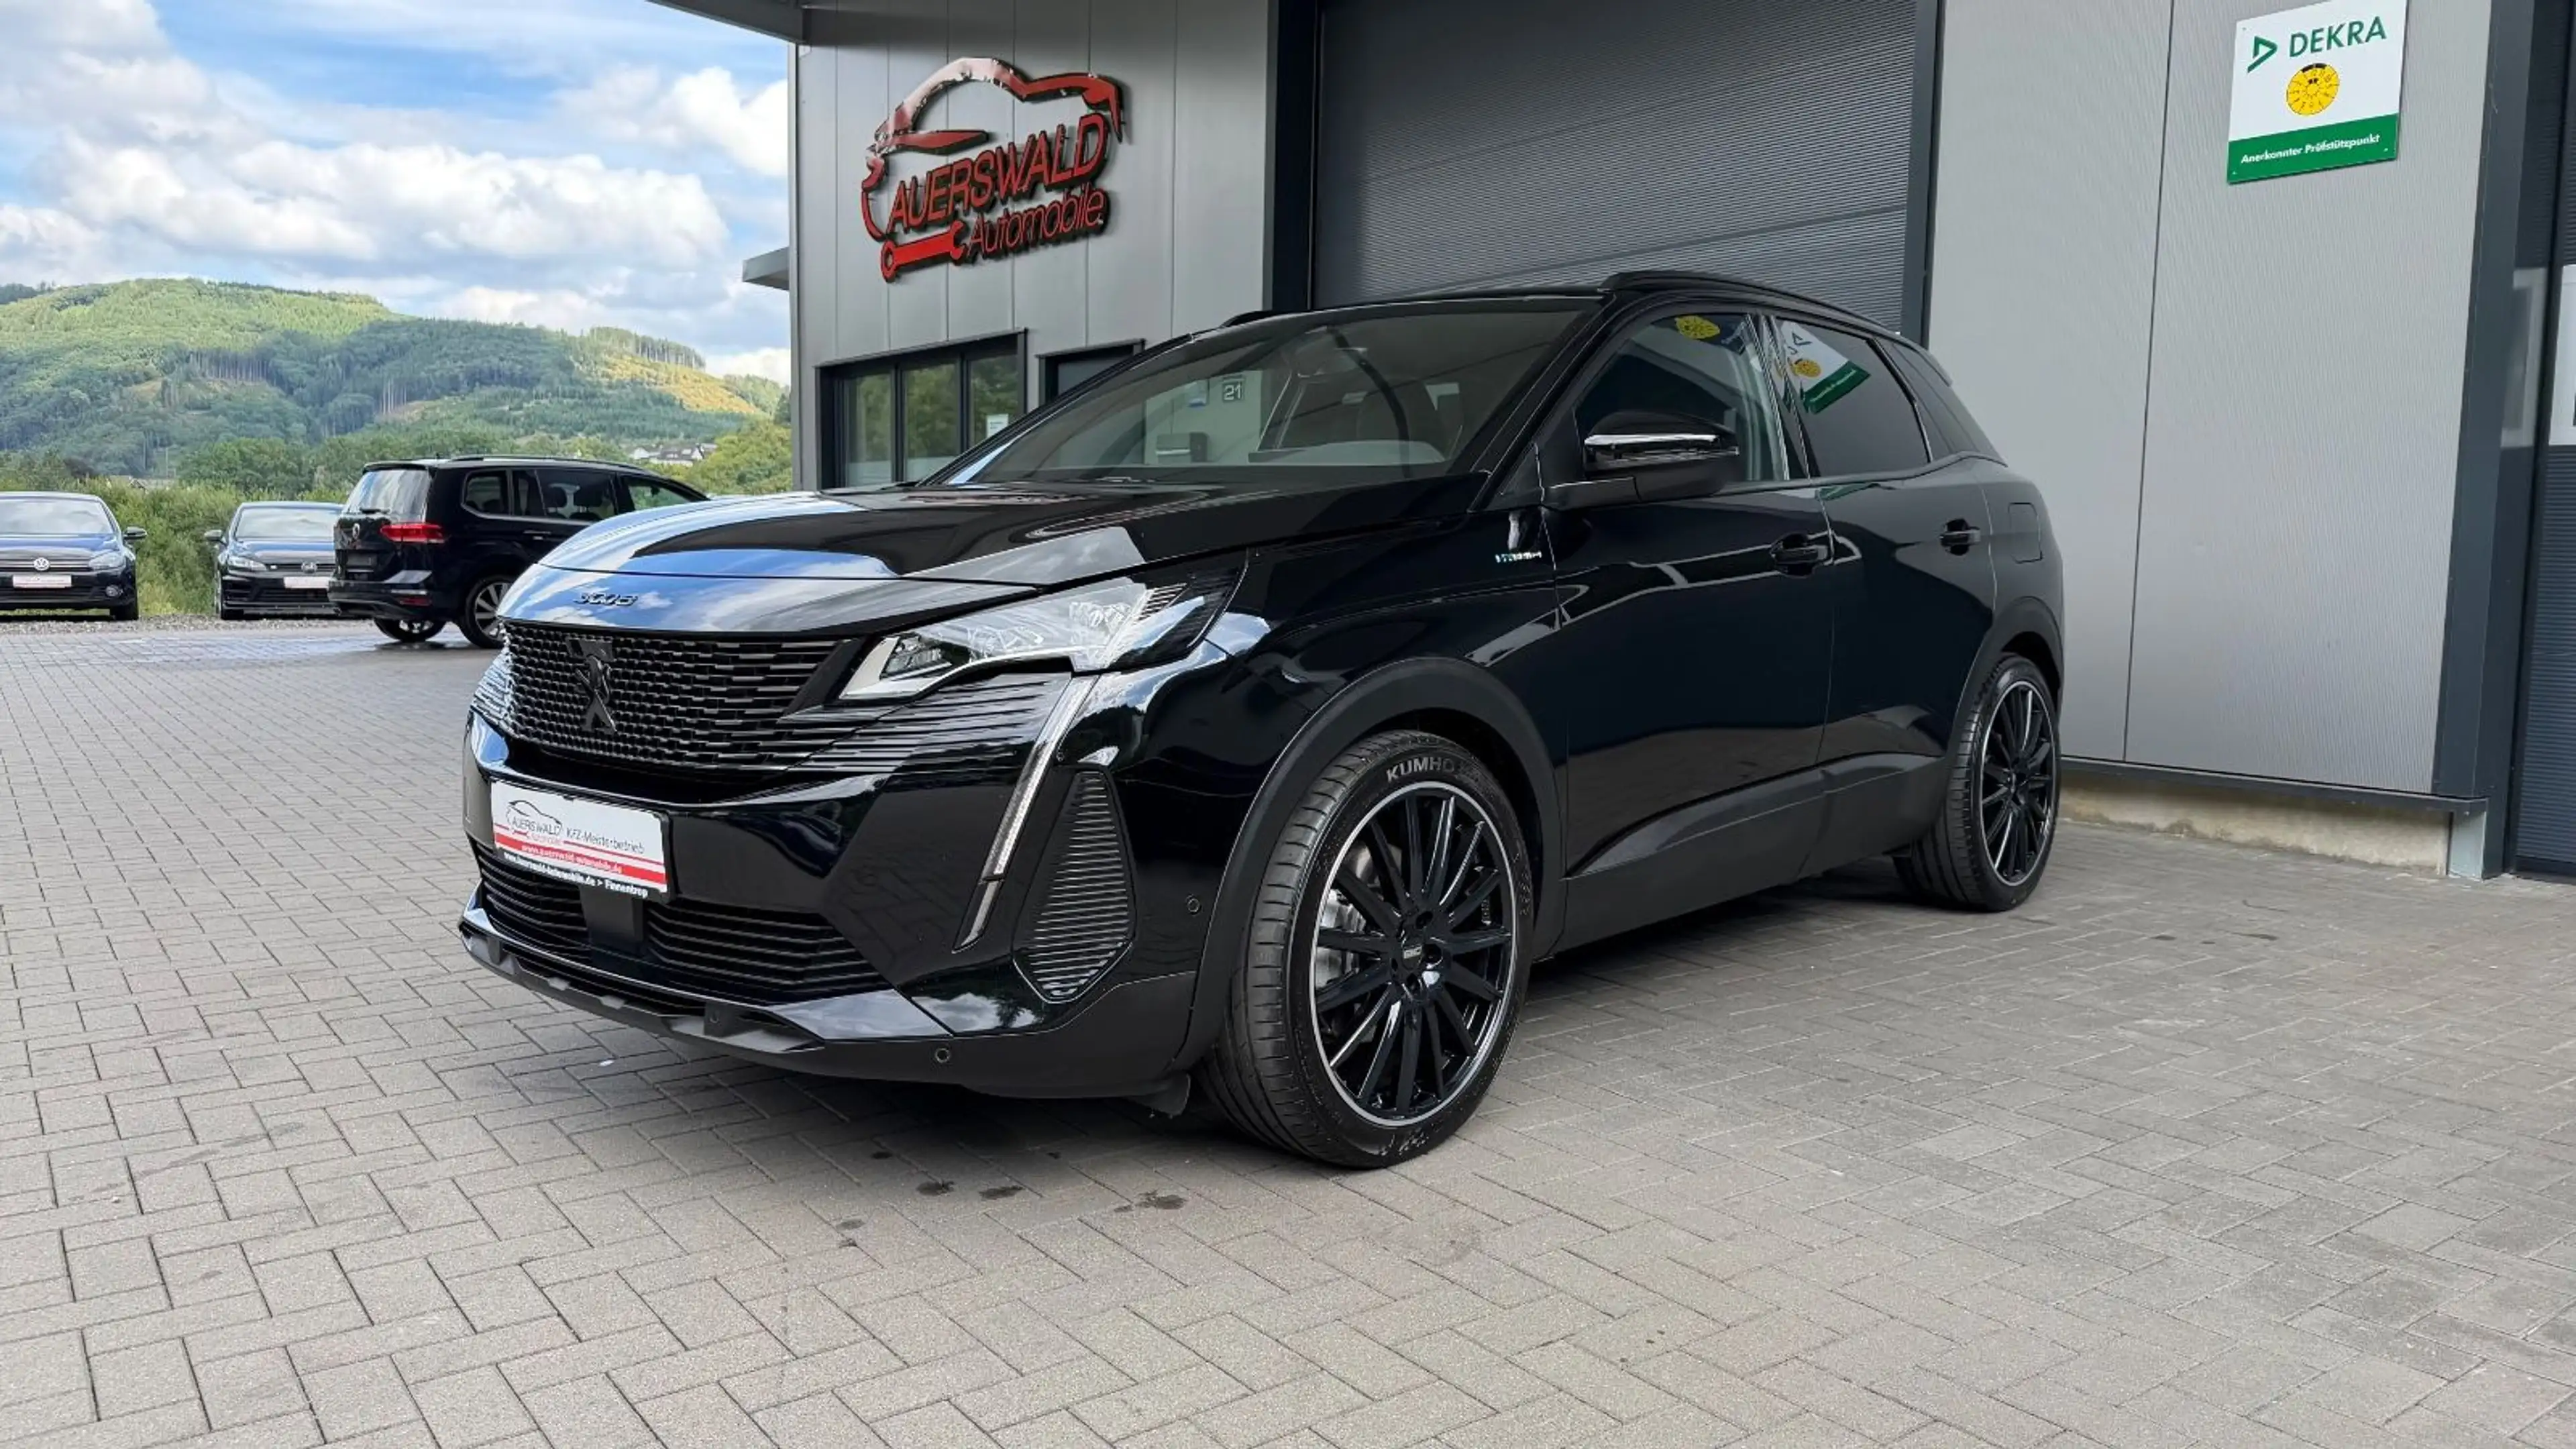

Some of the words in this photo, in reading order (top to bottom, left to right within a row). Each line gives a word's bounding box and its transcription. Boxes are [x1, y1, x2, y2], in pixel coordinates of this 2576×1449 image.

[2289, 15, 2387, 58] DEKRA
[2241, 147, 2302, 164] Anerkannter
[2305, 133, 2381, 154] Prüfstützpunkt
[885, 112, 1110, 235] AUERSWALD
[969, 182, 1108, 257] Automobile
[1224, 382, 1242, 400] 21
[1386, 756, 1455, 784] KUMHO
